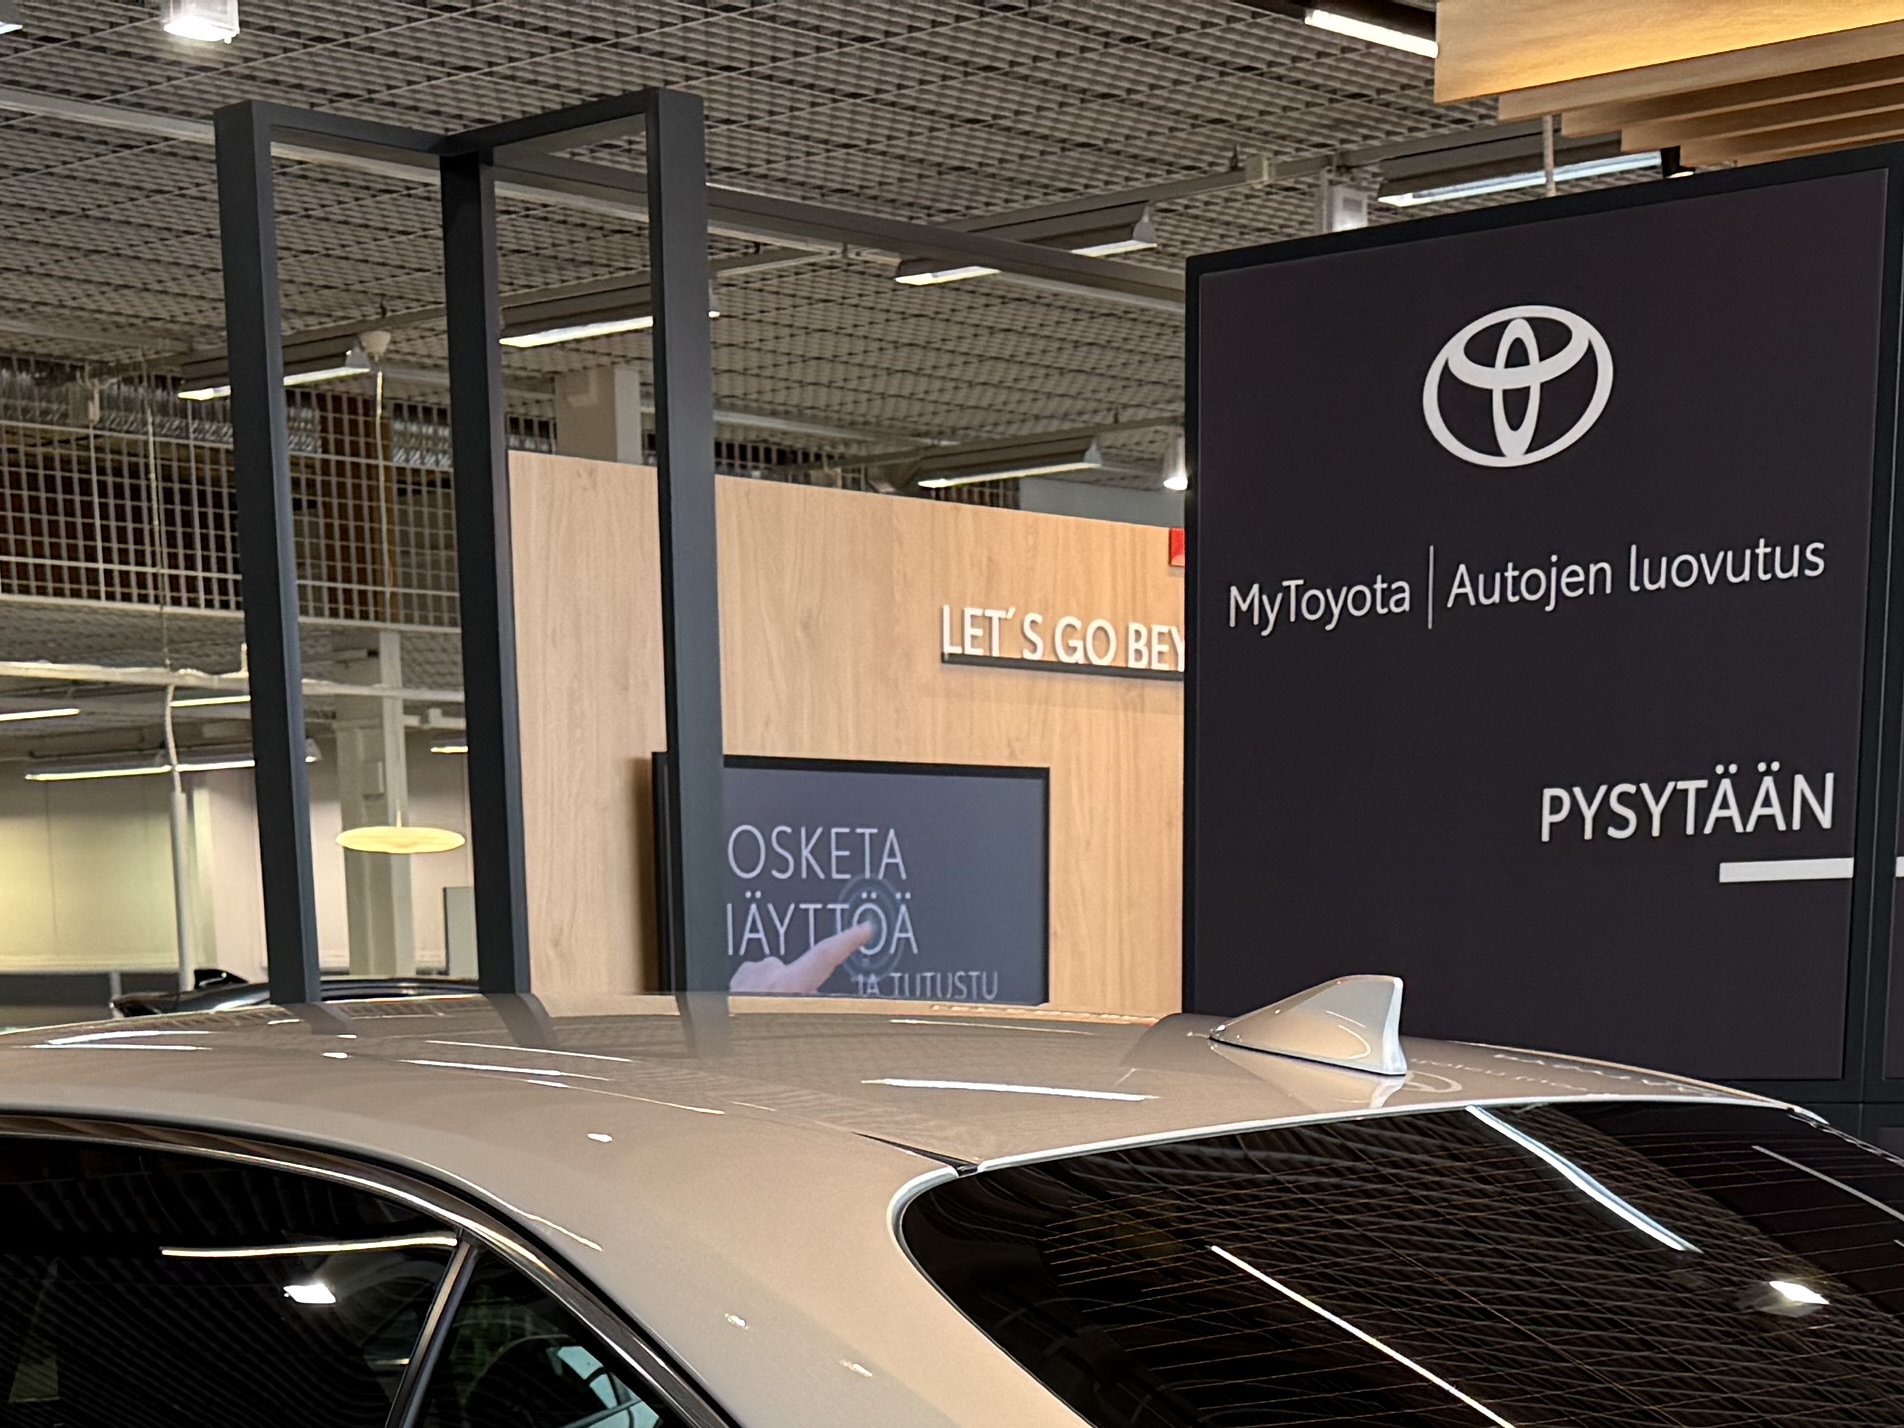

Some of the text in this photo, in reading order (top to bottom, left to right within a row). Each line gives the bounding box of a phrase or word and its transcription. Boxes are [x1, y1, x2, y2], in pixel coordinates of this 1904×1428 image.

[1227, 536, 1826, 636] MyToyota Autojen luovutus
[1054, 615, 1117, 667] GO
[1541, 762, 1835, 842] PYSYTÄÄN
[726, 890, 919, 956] ÄYTTÖÄ
